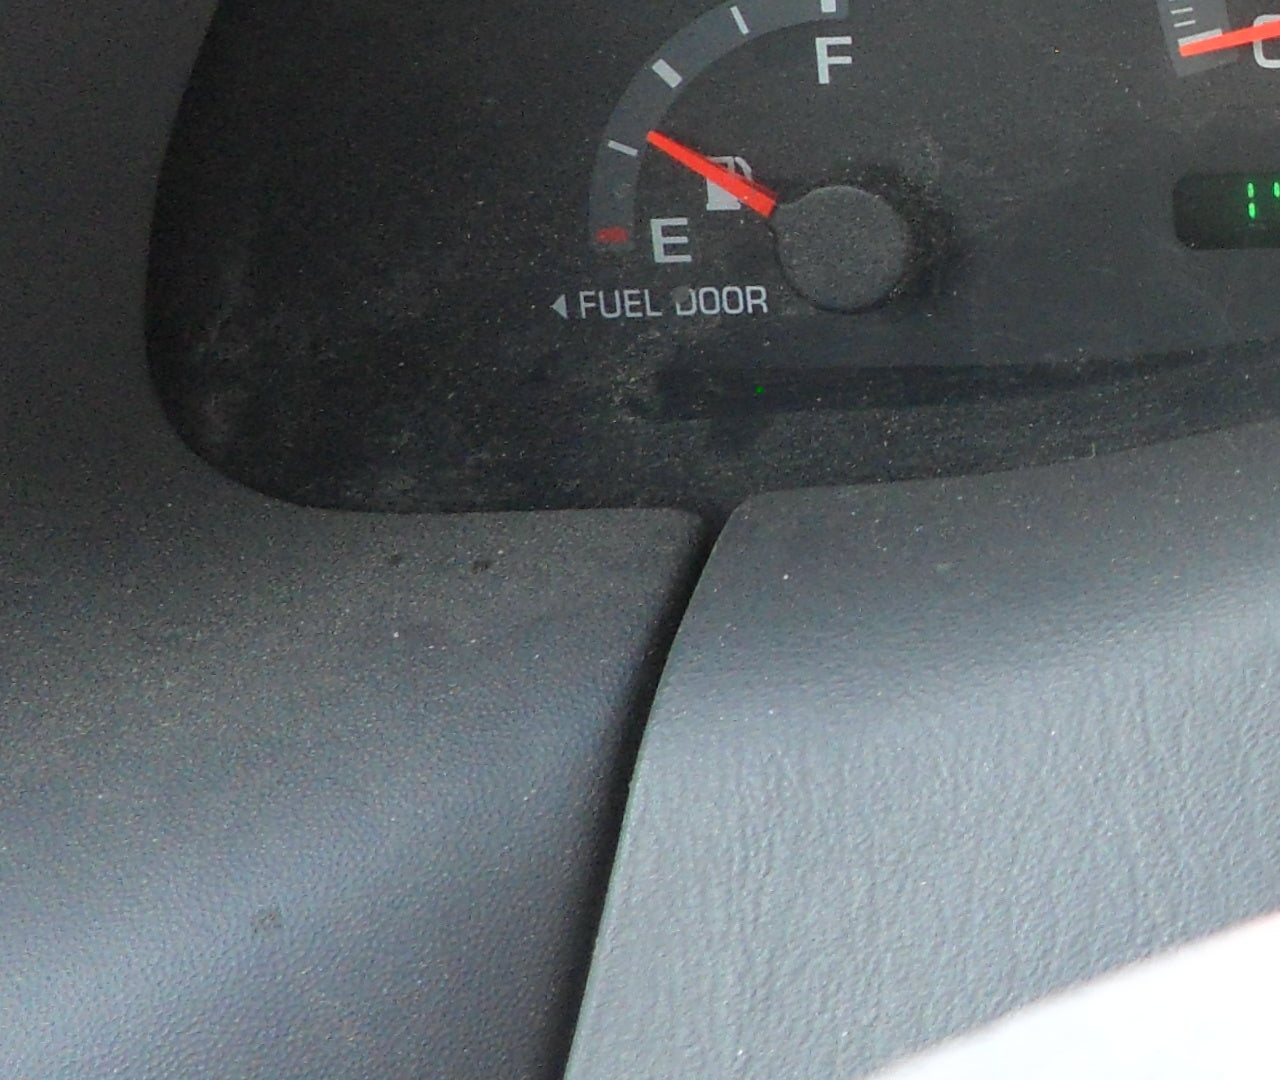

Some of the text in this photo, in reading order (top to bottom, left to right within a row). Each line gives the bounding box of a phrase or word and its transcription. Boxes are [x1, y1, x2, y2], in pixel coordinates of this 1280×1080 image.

[815, 35, 853, 85] F
[650, 217, 693, 264] E
[579, 285, 768, 319] FUEL DOOR
